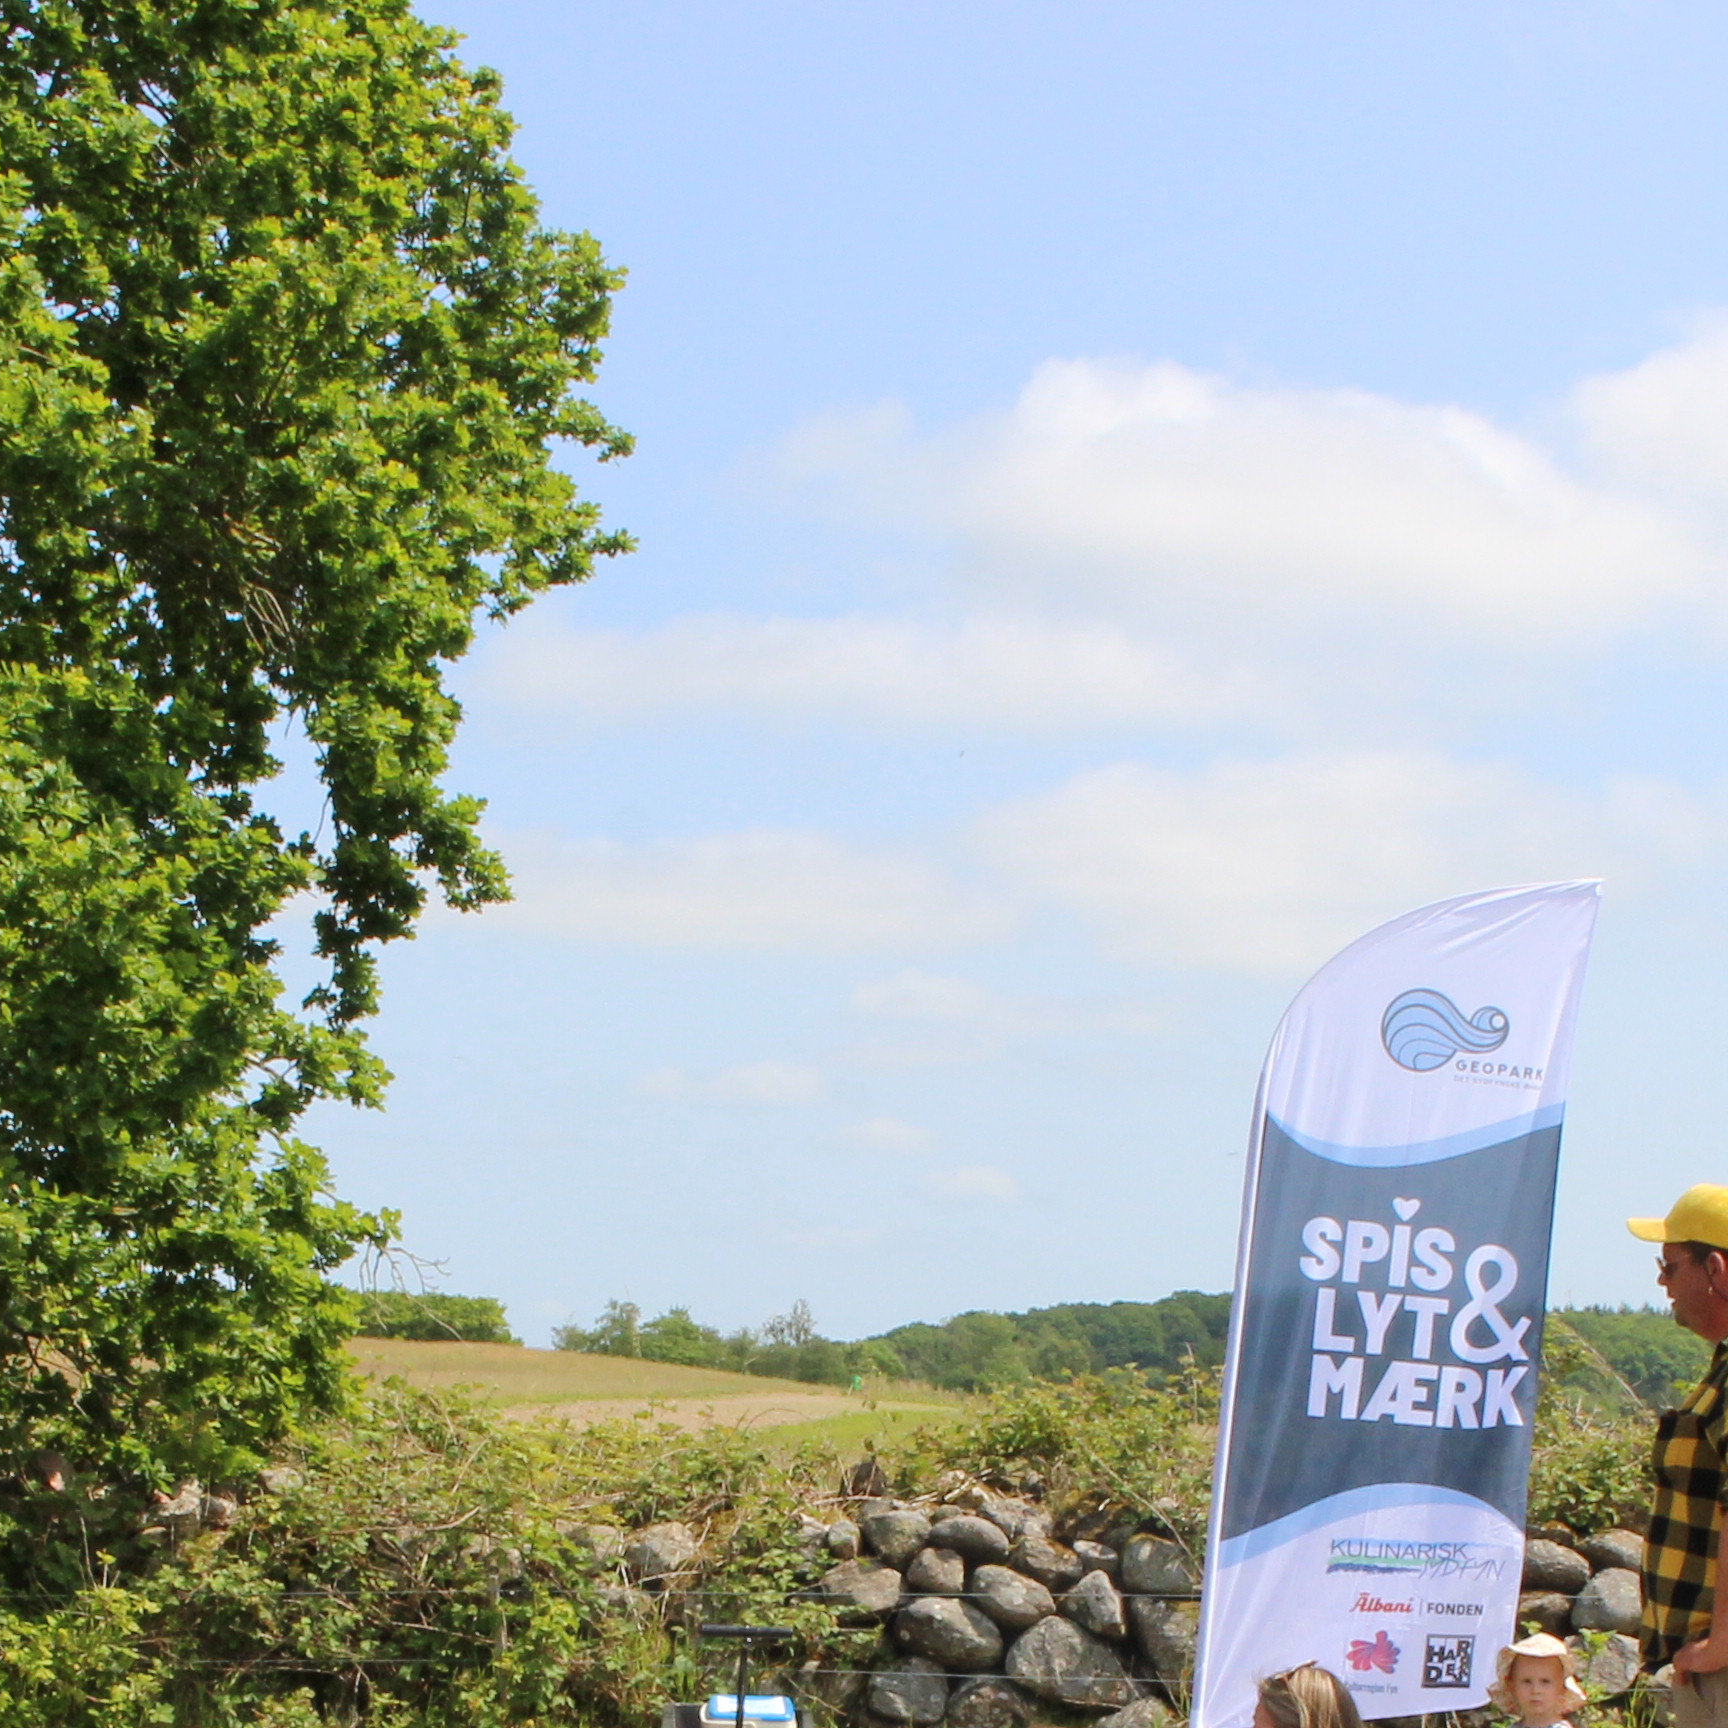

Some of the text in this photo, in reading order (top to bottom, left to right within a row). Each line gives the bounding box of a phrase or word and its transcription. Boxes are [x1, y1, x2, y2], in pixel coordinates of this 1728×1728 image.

[1455, 1060, 1544, 1081] GEOPARK
[1299, 1215, 1456, 1292] SPIS
[1312, 1244, 1532, 1364] LYT &
[1307, 1354, 1529, 1430] MÆRK
[1330, 1539, 1470, 1560] KULINARISK
[1427, 1602, 1484, 1616] FONDEN
